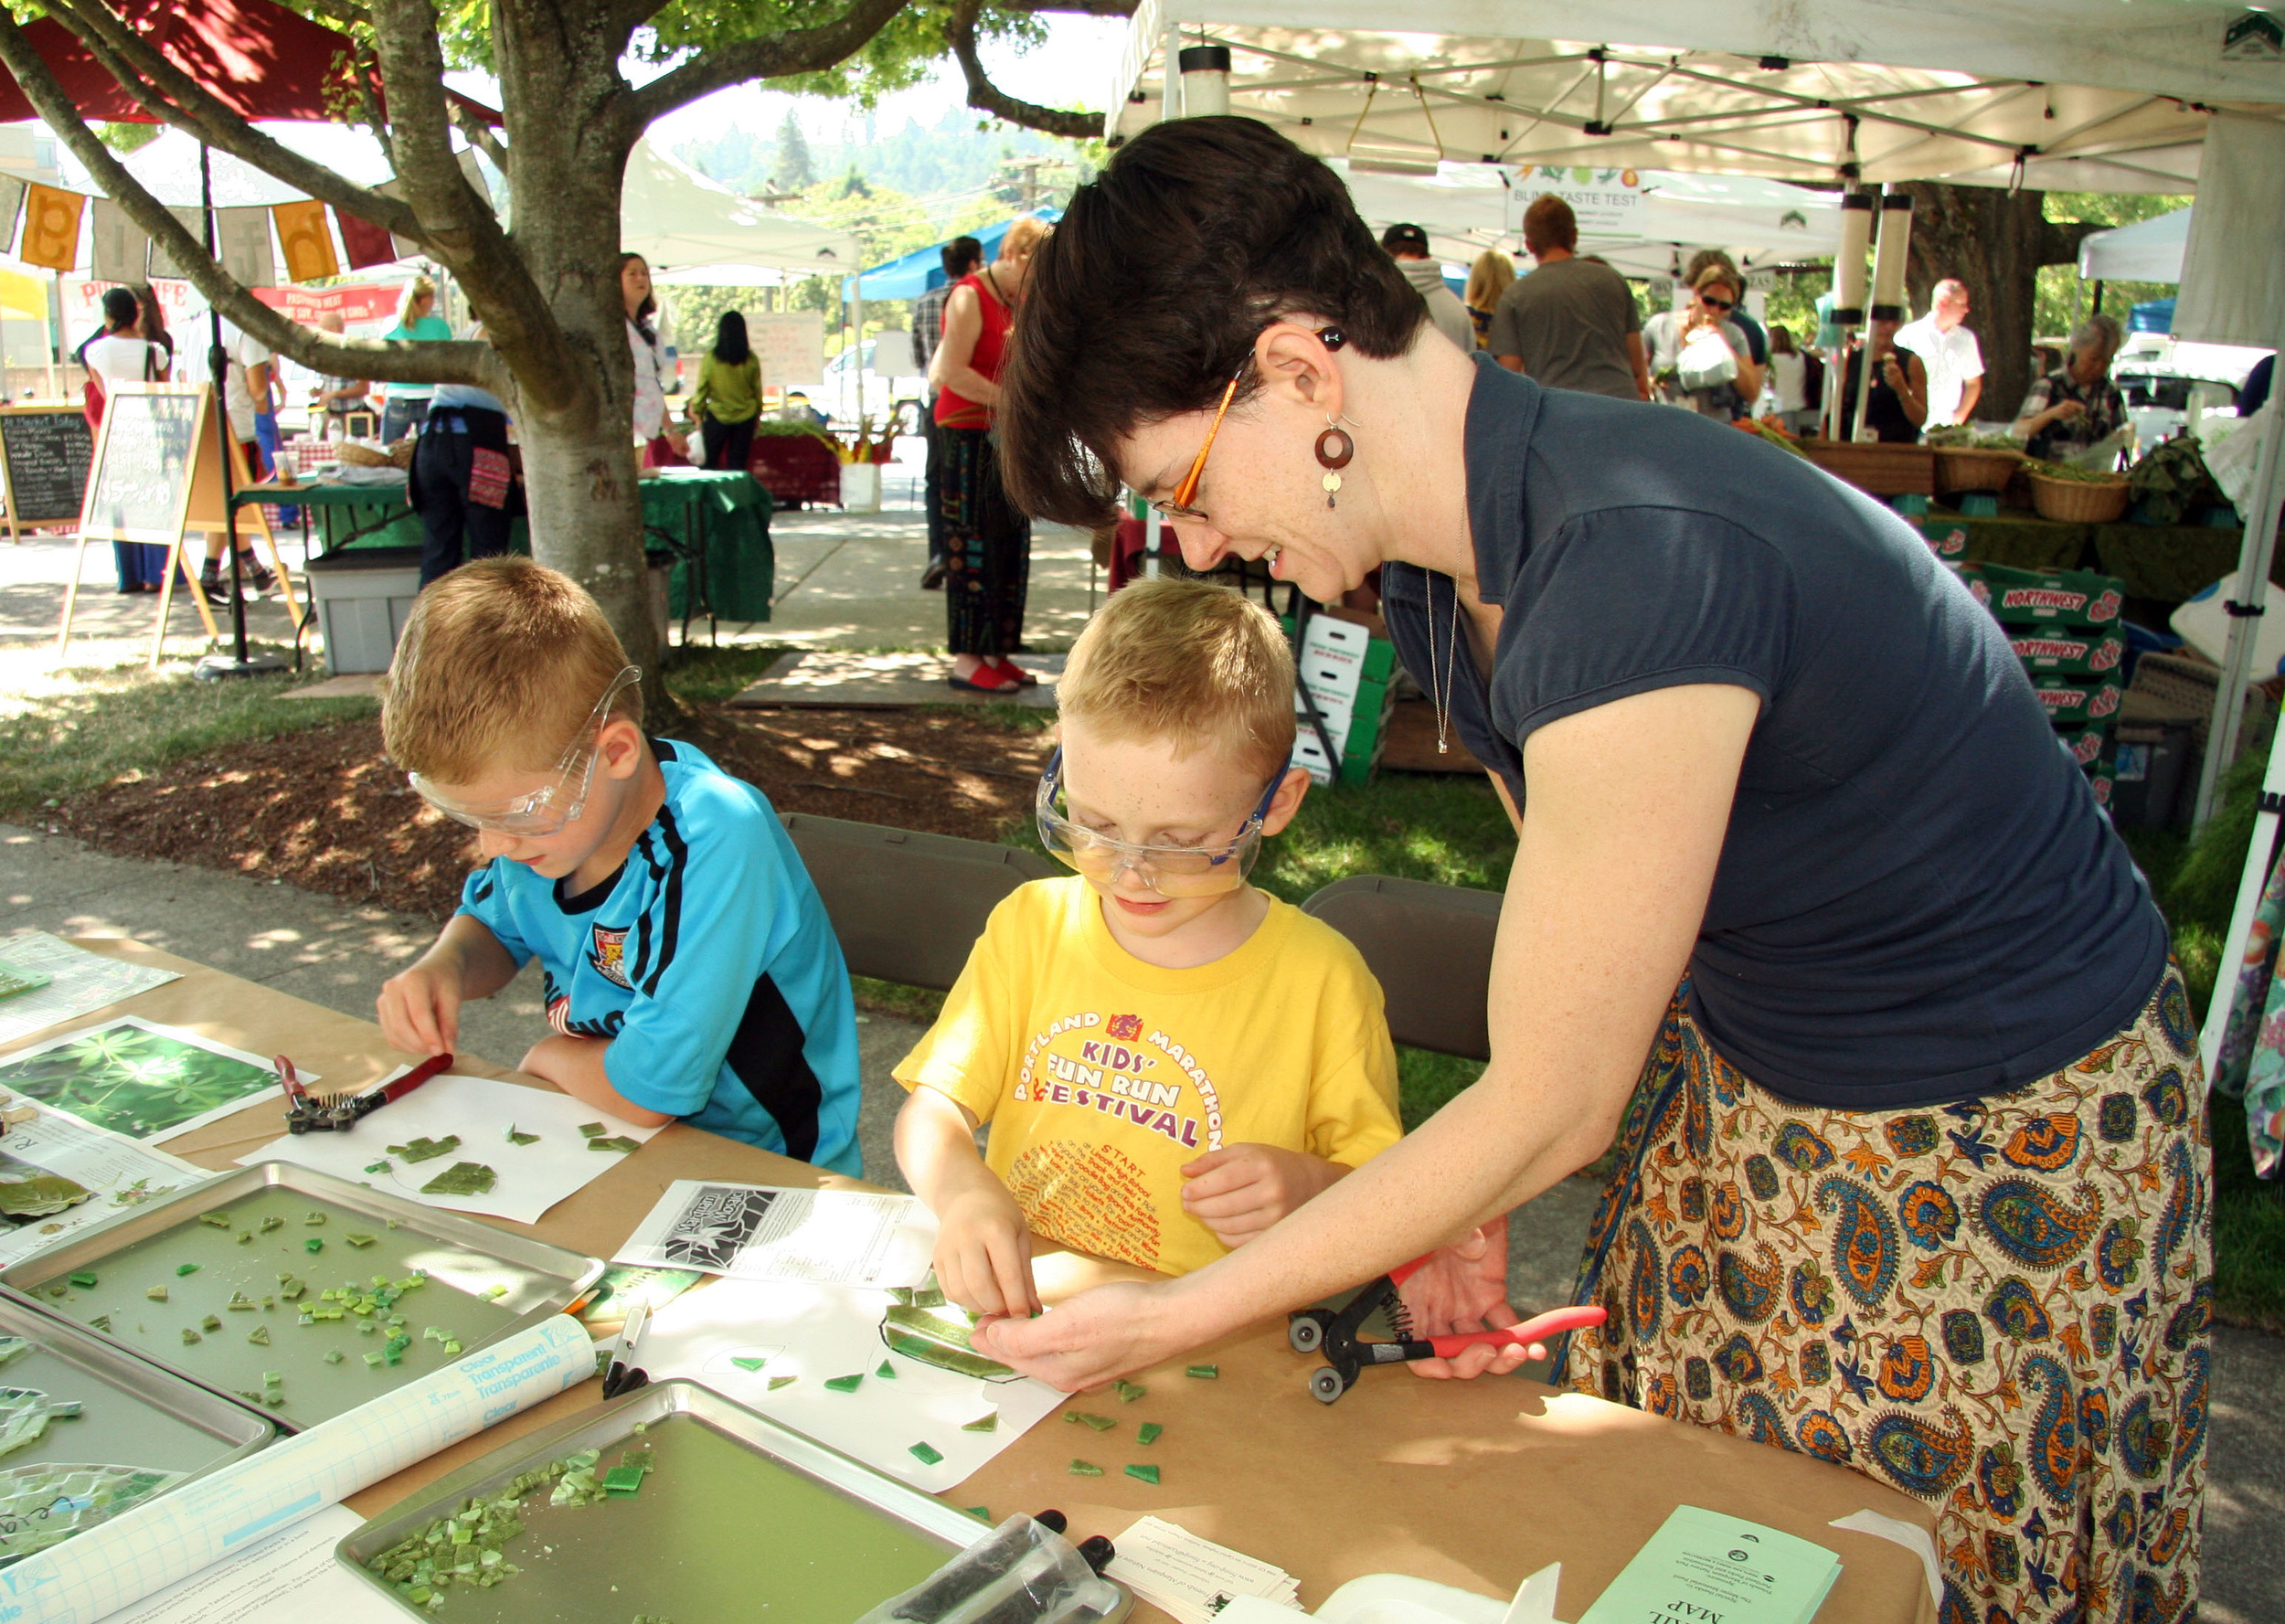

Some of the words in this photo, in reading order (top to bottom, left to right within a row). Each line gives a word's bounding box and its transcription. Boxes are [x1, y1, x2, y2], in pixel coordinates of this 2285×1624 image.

[1561, 191, 1600, 204] TASTE
[1604, 193, 1637, 206] TEST
[2002, 589, 2088, 610] NORTHWEST
[2011, 639, 2088, 658] ORTHWEST
[1014, 1012, 1101, 1101] PORTLAND
[1147, 1030, 1224, 1152] MARATHON
[1047, 1053, 1104, 1088] FUN
[1111, 1074, 1181, 1108] RUN
[1044, 1081, 1200, 1149] FESTIVAL
[1068, 1139, 1076, 1148] on
[1075, 1146, 1087, 1159] the
[1087, 1156, 1107, 1174] Track
[1106, 1172, 1121, 1185] and
[1120, 1183, 1136, 1198] Field
[1142, 1199, 1157, 1214] Pick
[1081, 1141, 1092, 1151] at
[1113, 1166, 1129, 1181] High
[1127, 1176, 1151, 1198] School
[1100, 1143, 1146, 1178] START
[711, 1190, 744, 1223] Mosaic
[1048, 1158, 1065, 1174] band
[1068, 1175, 1080, 1189] Buy
[1079, 1184, 1105, 1206] Tickets
[1104, 1204, 1116, 1215] for
[1114, 1213, 1134, 1229] Food
[1133, 1226, 1149, 1238] and
[1148, 1235, 1161, 1247] Fun
[1061, 1146, 1076, 1160] your
[1073, 1157, 1100, 1180] Goodie
[1097, 1176, 1111, 1191] Bag
[1109, 1185, 1124, 1199] and
[1121, 1195, 1136, 1209] Kids
[1134, 1206, 1147, 1218] Fun
[1145, 1214, 1160, 1226] Run
[1068, 1163, 1079, 1175] Put
[1078, 1173, 1089, 1184] on
[1087, 1182, 1105, 1197] your
[1105, 1193, 1127, 1215] Sports
[1127, 1213, 1161, 1237] Authority
[675, 1194, 718, 1233] Marquam
[1056, 1188, 1072, 1202] with
[1071, 1198, 1096, 1220] T-Bone
[1119, 1234, 1131, 1245] line
[1057, 1197, 1087, 1223] Proceed
[1085, 1220, 1104, 1236] along
[1105, 1232, 1117, 1244] the
[1116, 1241, 1132, 1257] Hula
[1059, 1183, 1081, 1199] gates
[1089, 1203, 1102, 1215] the
[1100, 1212, 1128, 1233] Festival
[1125, 1229, 1142, 1243] and
[1141, 1240, 1159, 1257] Warm
[1075, 1220, 1089, 1235] your
[1106, 1245, 1120, 1257] 2-5
[460, 1353, 496, 1373] Clear
[468, 1343, 546, 1384] Transparent
[477, 1354, 560, 1398] Transparente
[484, 1400, 517, 1421] Clear
[237, 1547, 263, 1565] Portland
[1145, 1564, 1177, 1583] Marquam
[1667, 1600, 1725, 1624] MAP
